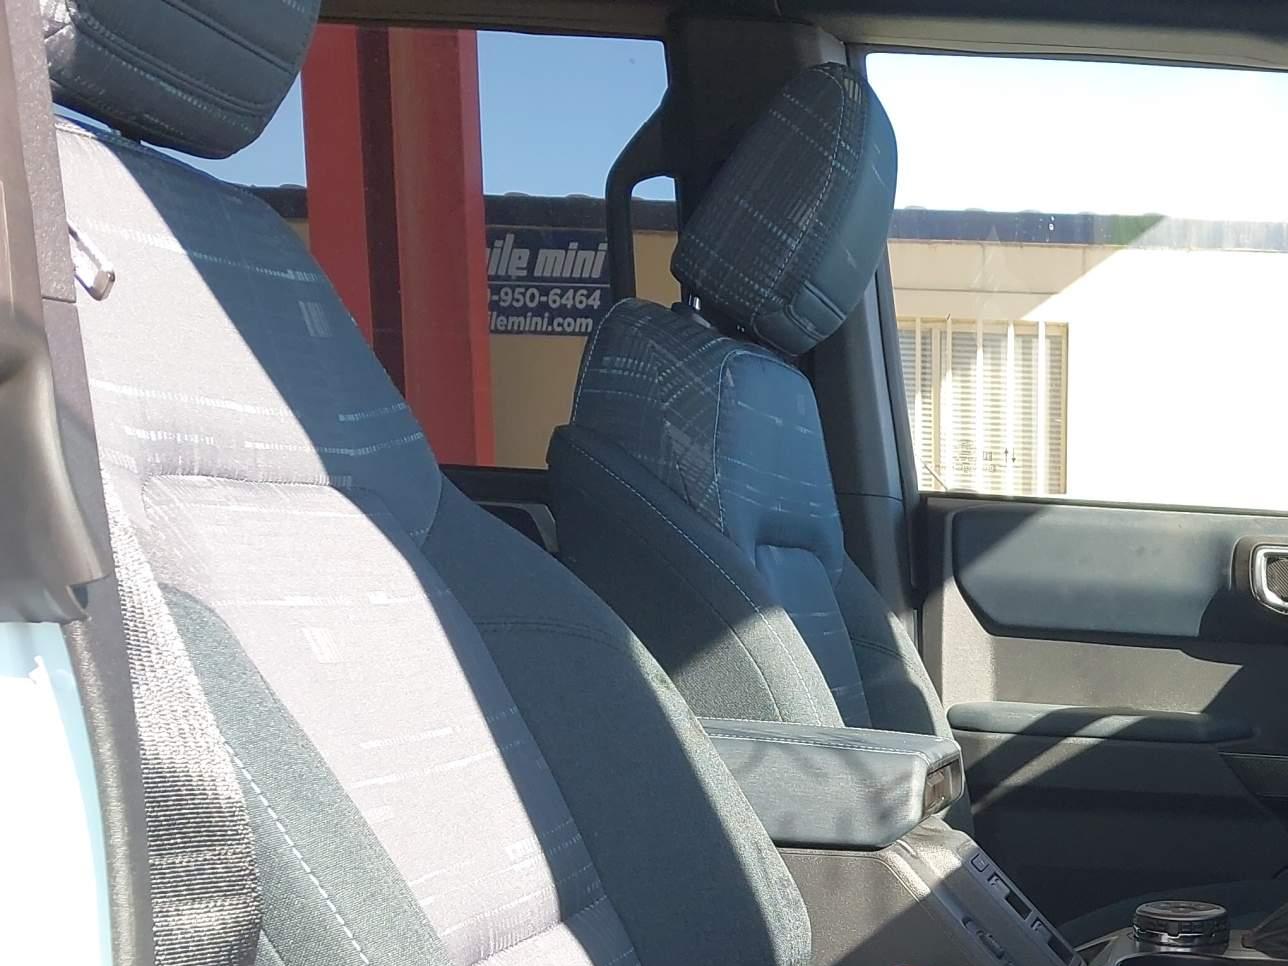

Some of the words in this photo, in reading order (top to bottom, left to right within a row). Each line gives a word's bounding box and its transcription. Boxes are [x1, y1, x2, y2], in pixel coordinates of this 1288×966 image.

[485, 233, 530, 277] ile
[534, 242, 608, 278] mini
[487, 287, 601, 310] -950-6464
